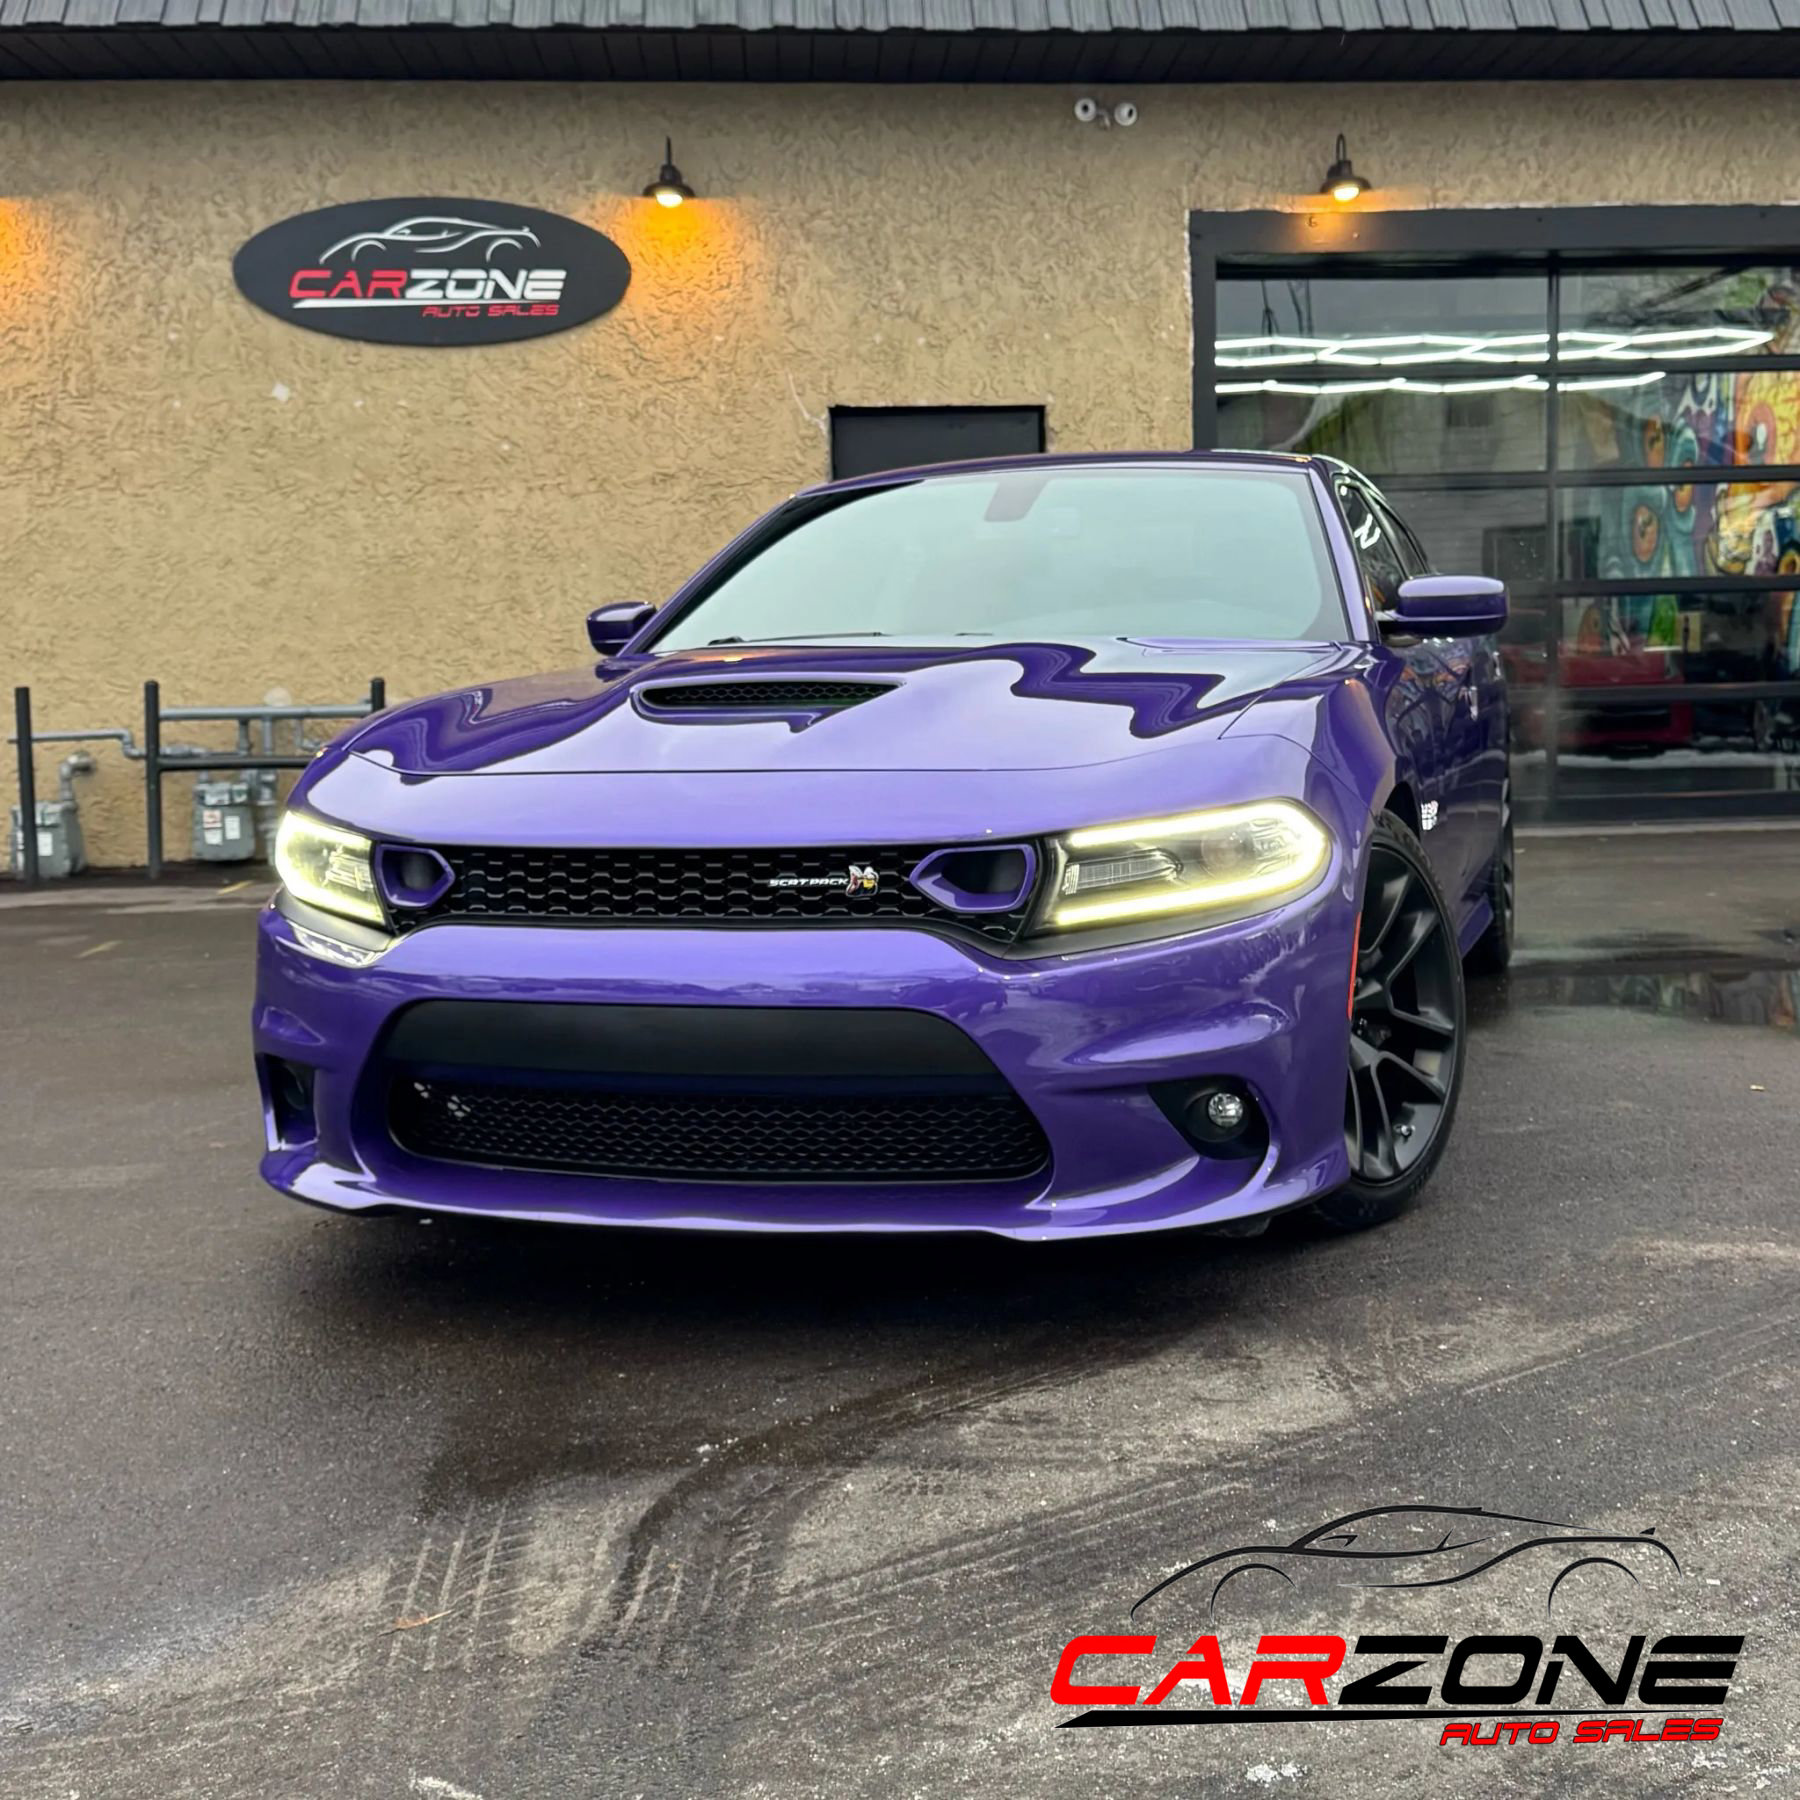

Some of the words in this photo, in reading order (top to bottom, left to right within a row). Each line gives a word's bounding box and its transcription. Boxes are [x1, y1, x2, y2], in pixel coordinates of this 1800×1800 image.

[288, 269, 567, 300] CARZONE
[422, 305, 480, 318] AUTO
[487, 304, 560, 317] SALES
